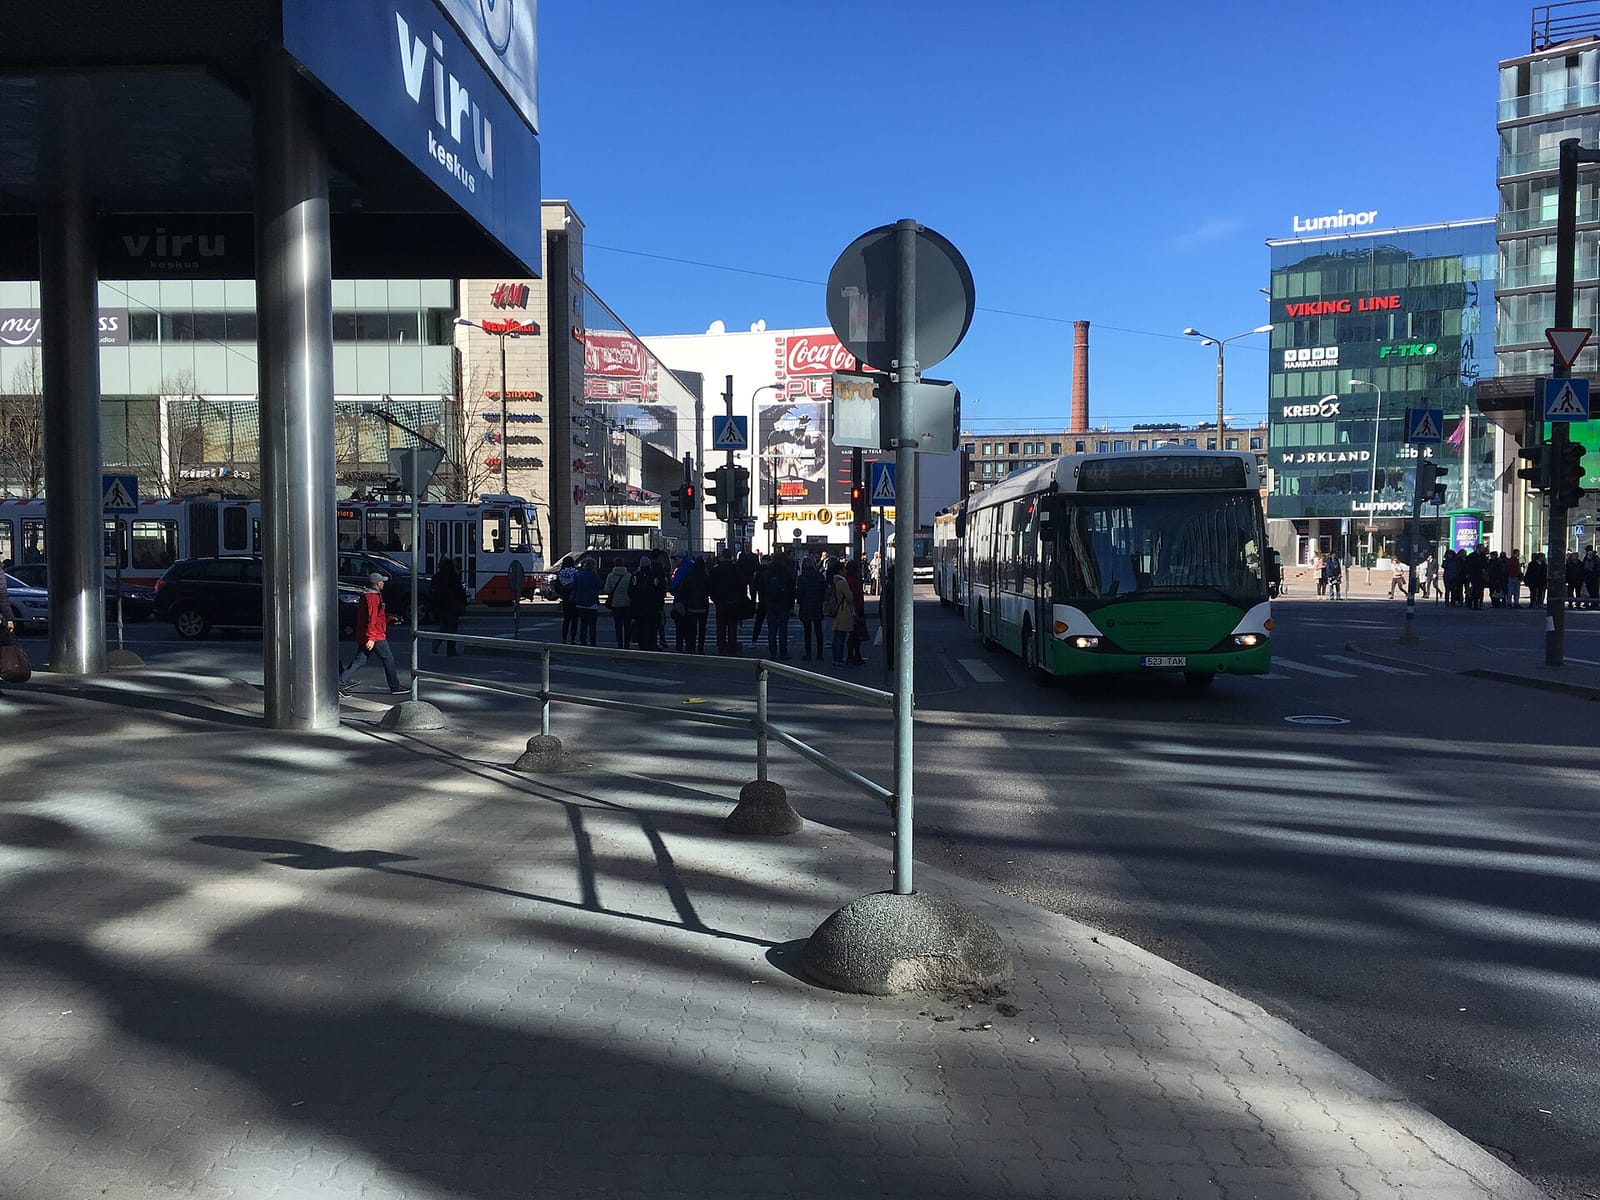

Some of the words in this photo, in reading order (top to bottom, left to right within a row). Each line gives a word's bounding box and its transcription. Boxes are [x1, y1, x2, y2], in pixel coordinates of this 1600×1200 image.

[396, 11, 493, 179] viru
[428, 129, 475, 193] keskus
[1293, 209, 1378, 232] Luminor
[122, 227, 225, 256] viru
[1286, 300, 1351, 317] VIKING
[1359, 295, 1401, 311] LINE
[788, 338, 856, 371] Coca-Co
[1283, 395, 1340, 417] KREDEX
[336, 510, 354, 518] riorg
[1352, 499, 1405, 511] Luminor
[1148, 657, 1162, 666] 523
[1167, 657, 1185, 665] TAK
